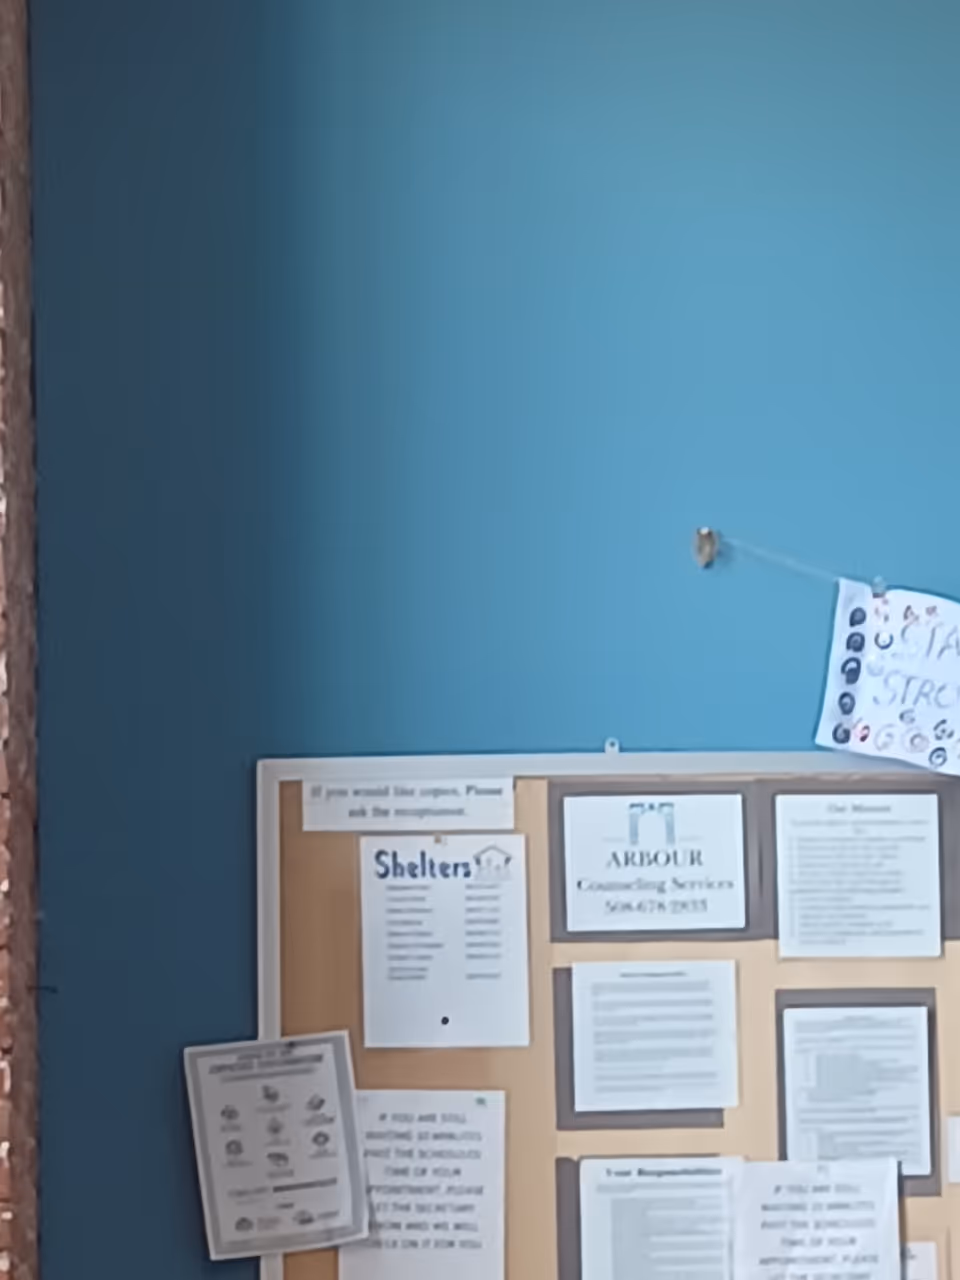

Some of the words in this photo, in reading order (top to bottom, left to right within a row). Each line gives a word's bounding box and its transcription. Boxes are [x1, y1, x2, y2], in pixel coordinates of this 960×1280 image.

[374, 849, 471, 879] Shelters
[605, 849, 703, 869] ARBOUR
[670, 877, 734, 890] Services
